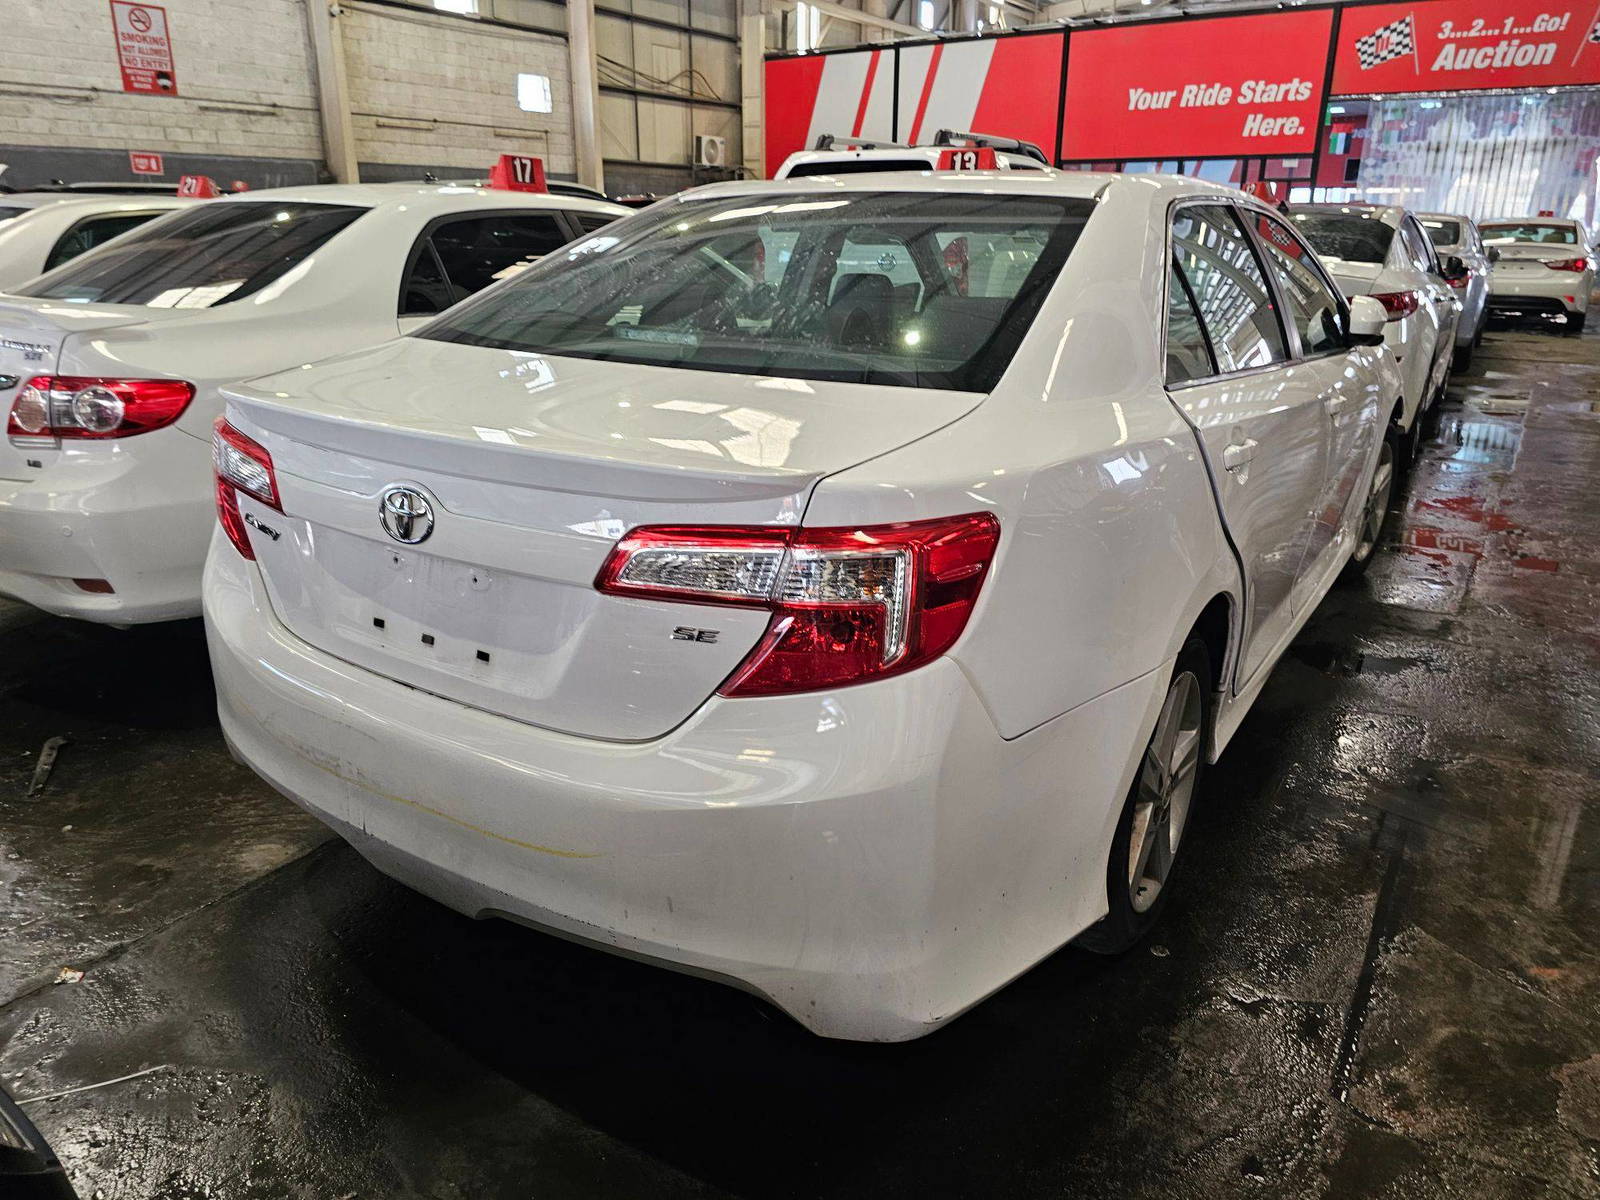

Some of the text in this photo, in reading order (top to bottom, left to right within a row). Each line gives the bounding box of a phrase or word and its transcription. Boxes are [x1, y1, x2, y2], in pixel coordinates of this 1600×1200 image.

[121, 32, 166, 47] SMOKING
[125, 57, 169, 70] NO ENTRY
[1430, 39, 1557, 71] Auction
[1128, 77, 1313, 111] Your Ride Starts
[1242, 113, 1305, 137] Here.
[513, 157, 532, 184] 17
[672, 625, 721, 644] SE
